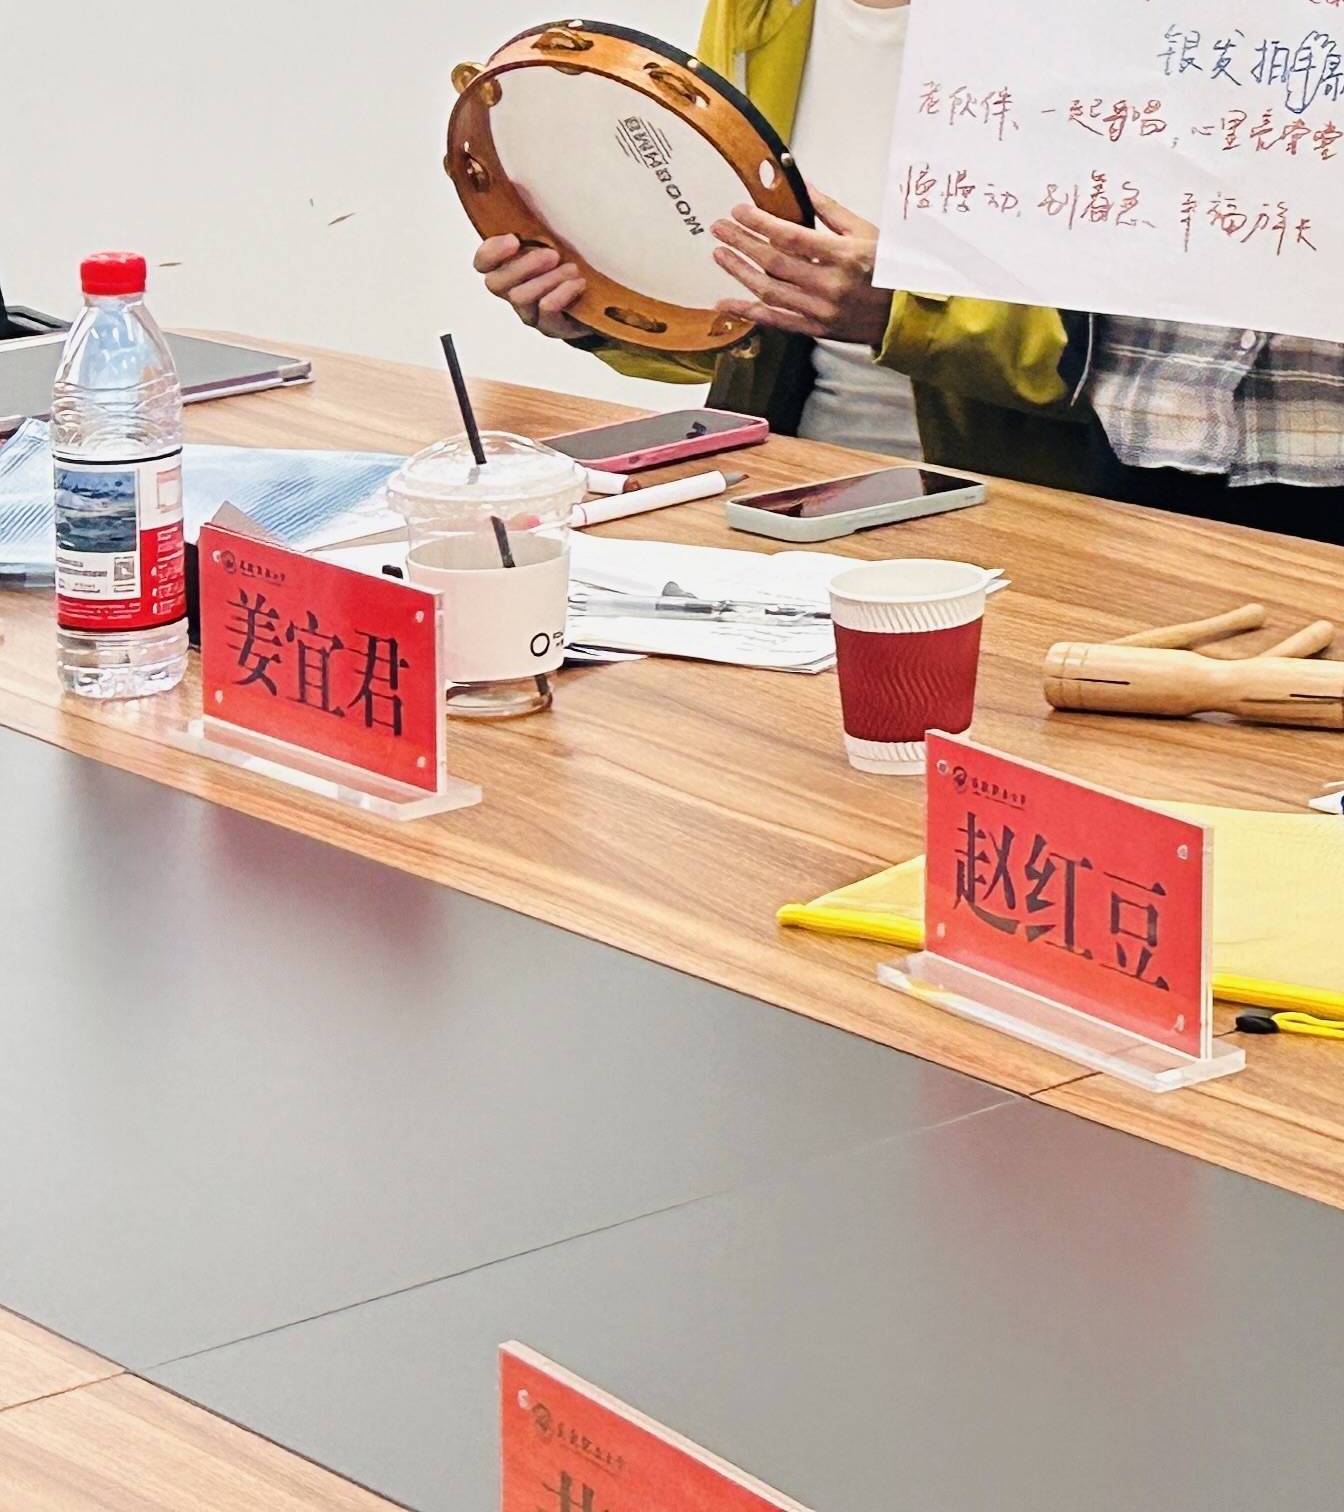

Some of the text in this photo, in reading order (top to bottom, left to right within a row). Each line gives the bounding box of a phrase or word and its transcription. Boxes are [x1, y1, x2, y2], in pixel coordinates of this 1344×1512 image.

[225, 588, 410, 737] 姜宜君
[953, 811, 1170, 992] 赵红豆
